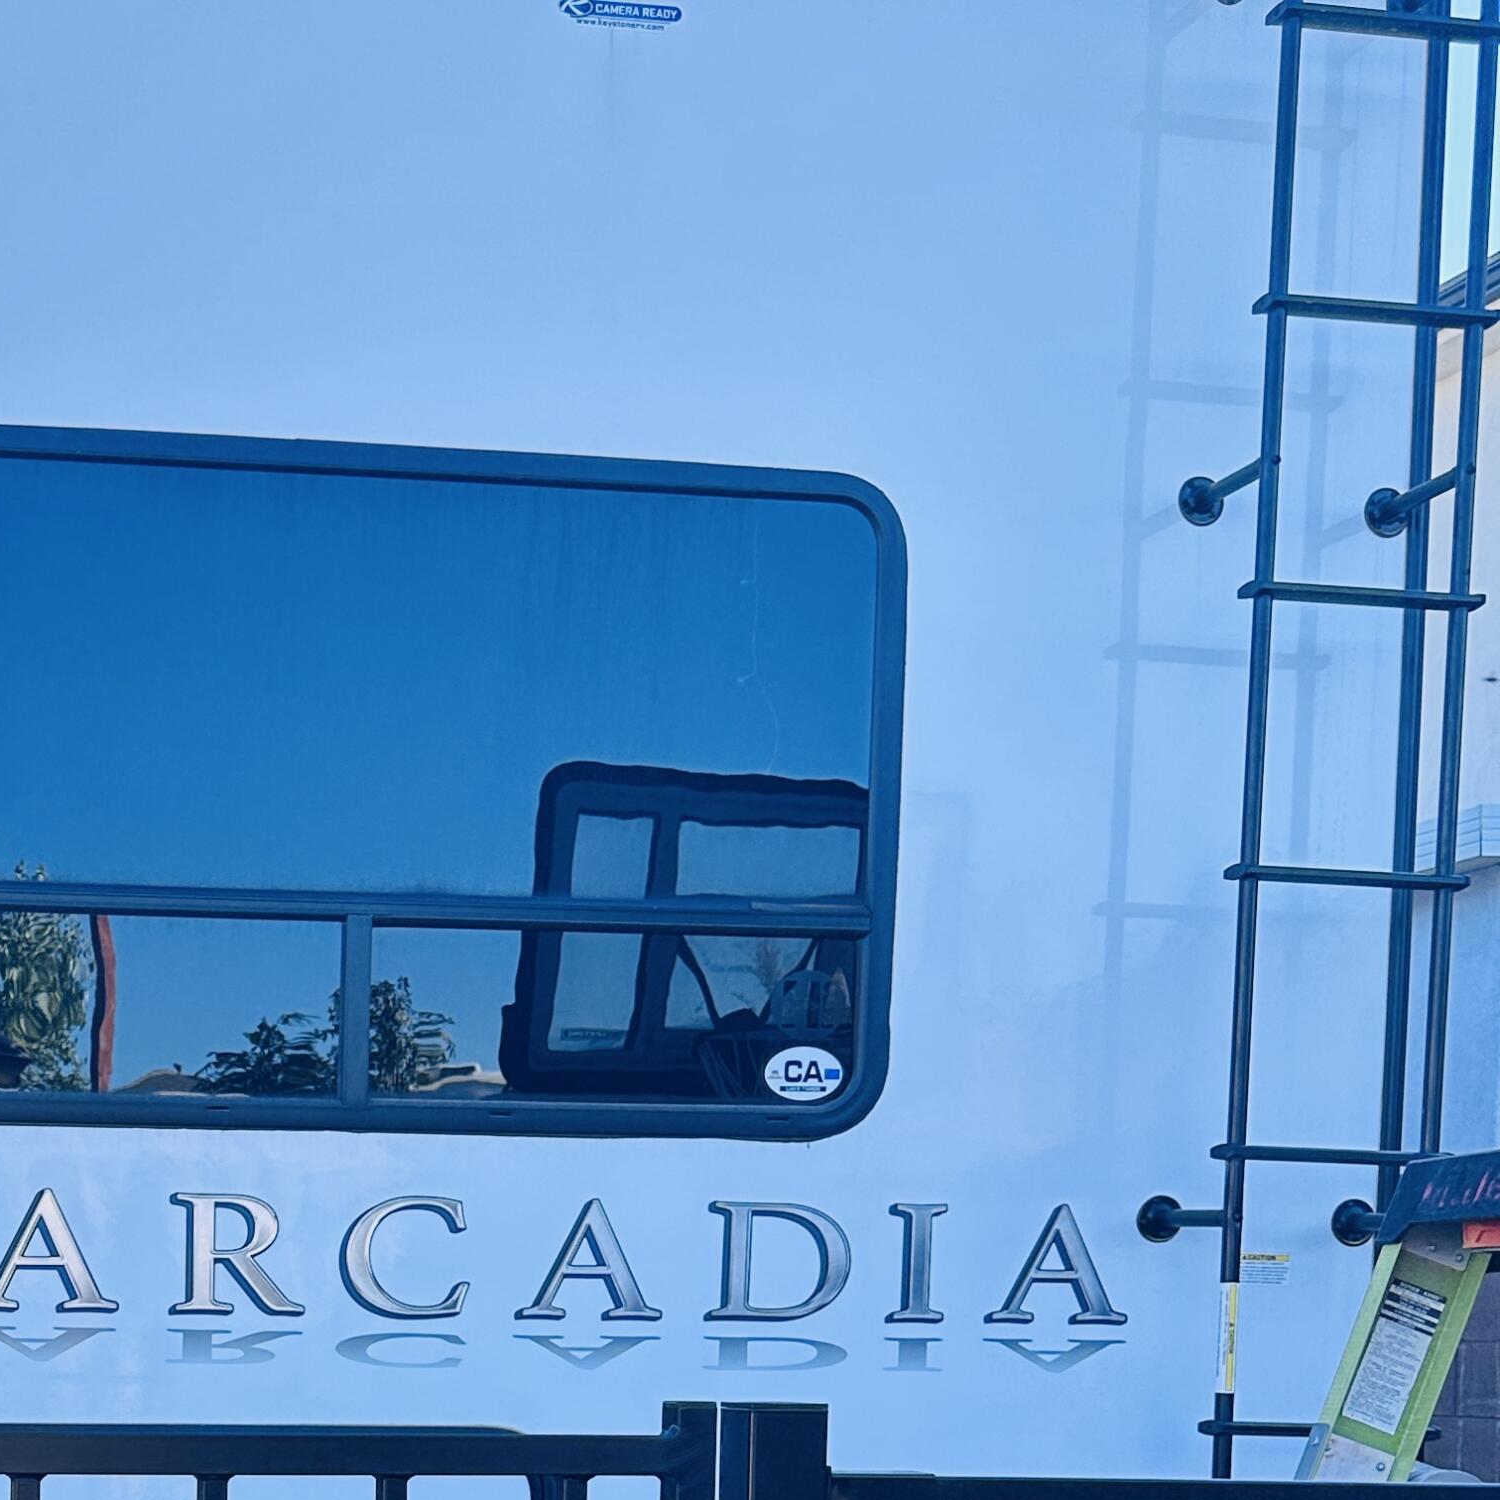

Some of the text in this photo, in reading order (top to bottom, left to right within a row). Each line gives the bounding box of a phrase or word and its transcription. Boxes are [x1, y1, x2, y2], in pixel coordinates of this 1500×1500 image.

[595, 3, 678, 20] CAMERA READY
[784, 1060, 823, 1083] CA
